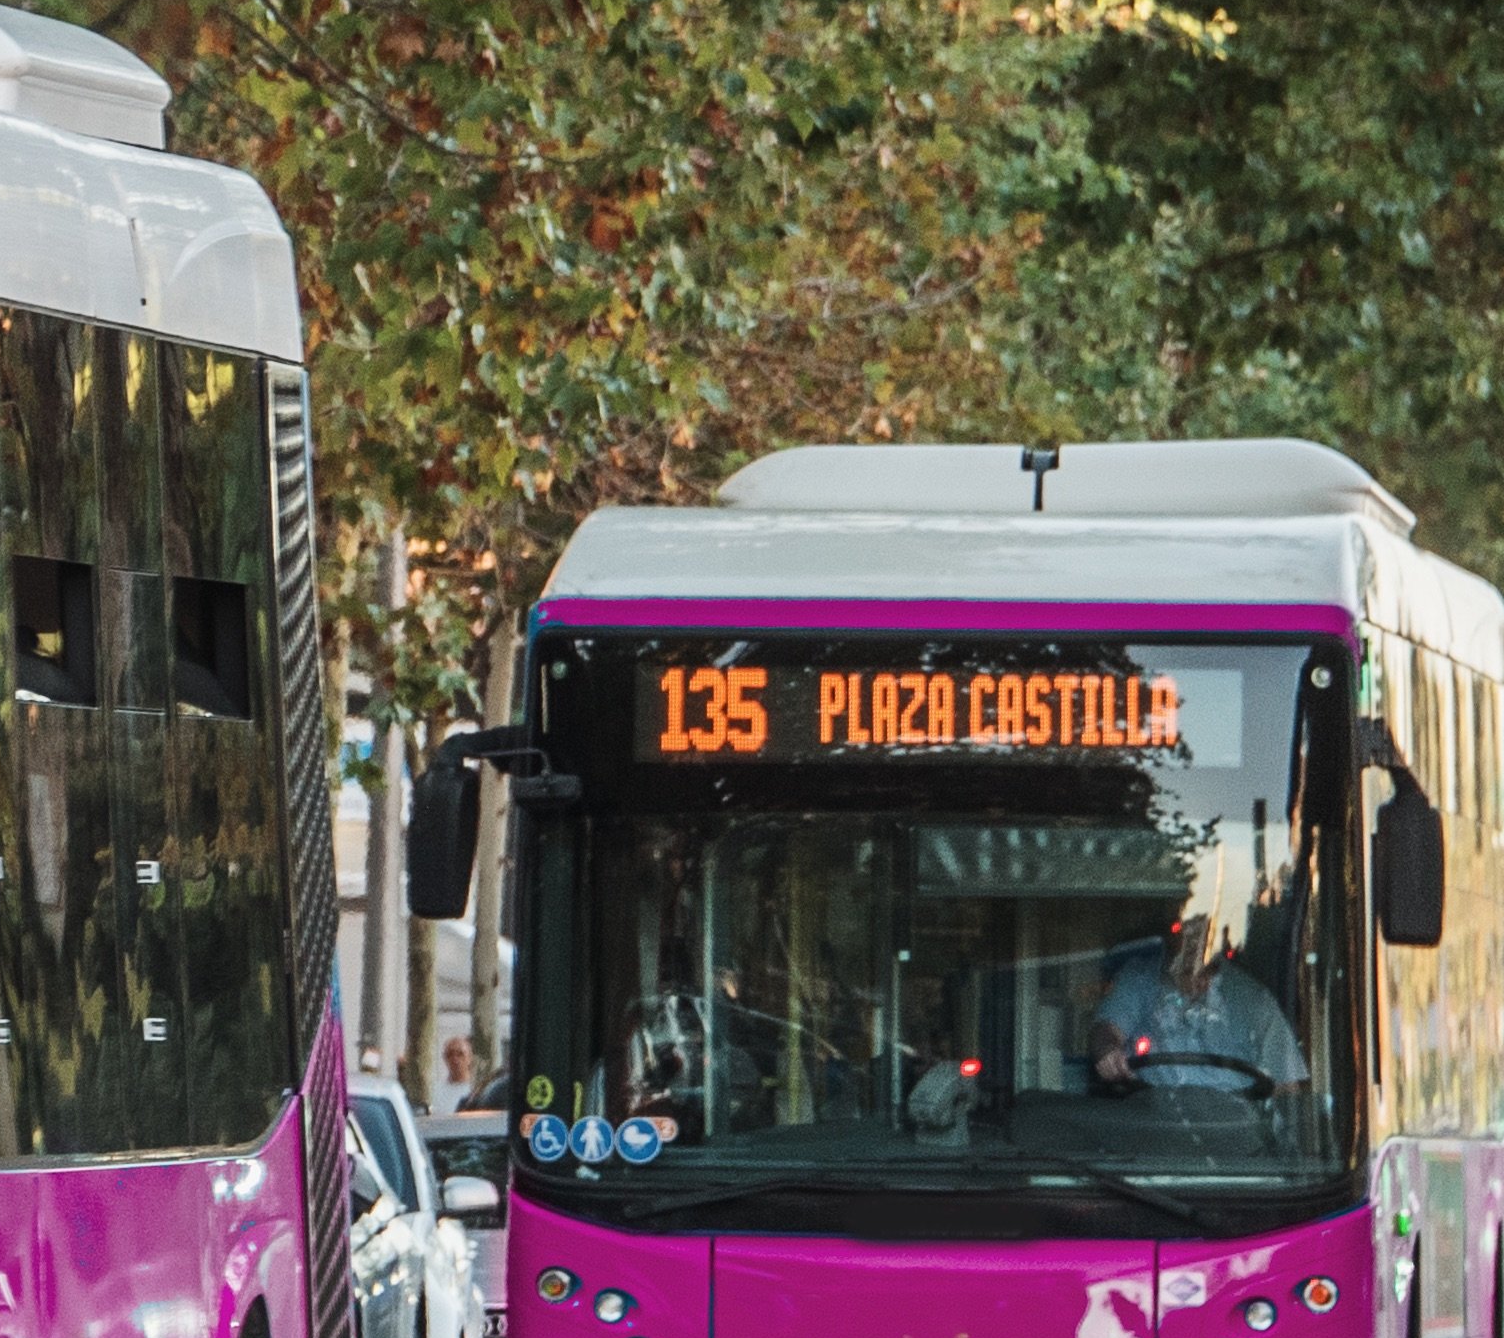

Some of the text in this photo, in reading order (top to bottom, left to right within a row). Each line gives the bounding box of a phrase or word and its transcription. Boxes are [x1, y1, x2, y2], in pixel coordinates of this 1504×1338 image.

[659, 666, 1179, 753] 135 PLAZA CASTILLA
